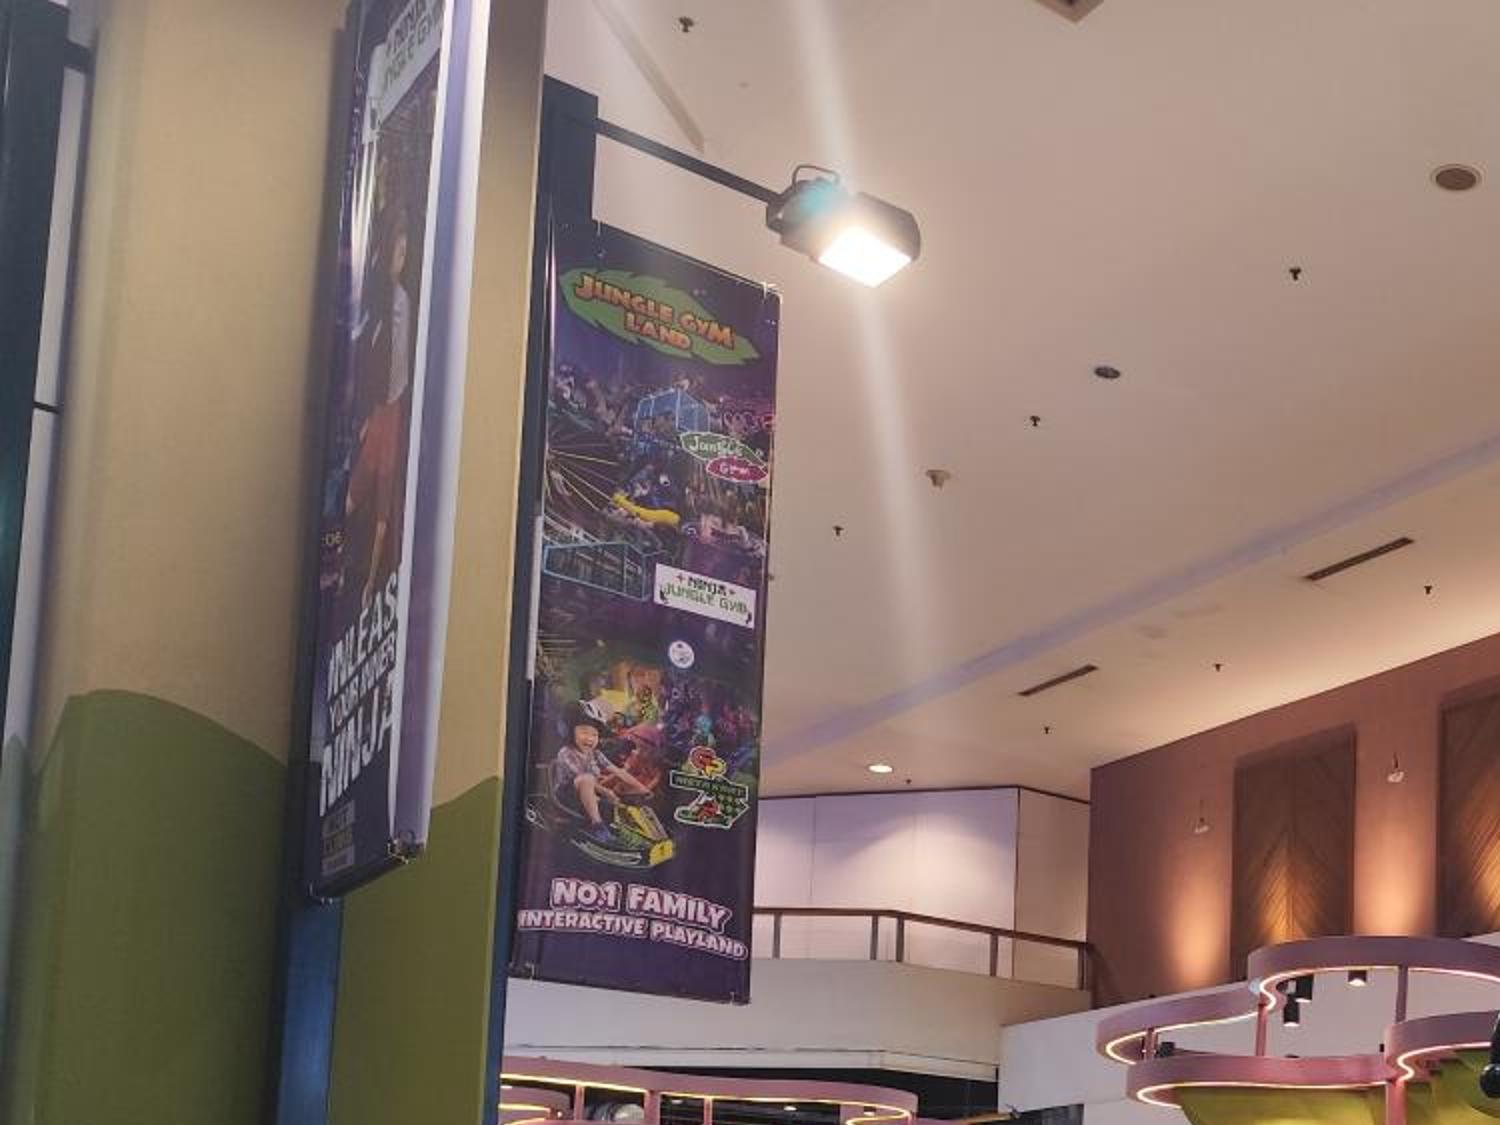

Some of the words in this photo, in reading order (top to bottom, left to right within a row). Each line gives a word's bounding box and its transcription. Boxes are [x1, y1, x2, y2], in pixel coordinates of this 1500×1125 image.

[575, 272, 674, 321] JUNGLE
[678, 311, 736, 350] GYM
[624, 311, 692, 350] LAND
[664, 582, 715, 606] JUNGLE
[327, 571, 398, 703] UNLEAS
[320, 672, 394, 817] NINJA
[552, 878, 621, 910] NO.1
[627, 884, 731, 932] FAMILY
[518, 910, 648, 937] INTERACTIVE
[650, 920, 748, 959] PLAYLAND
